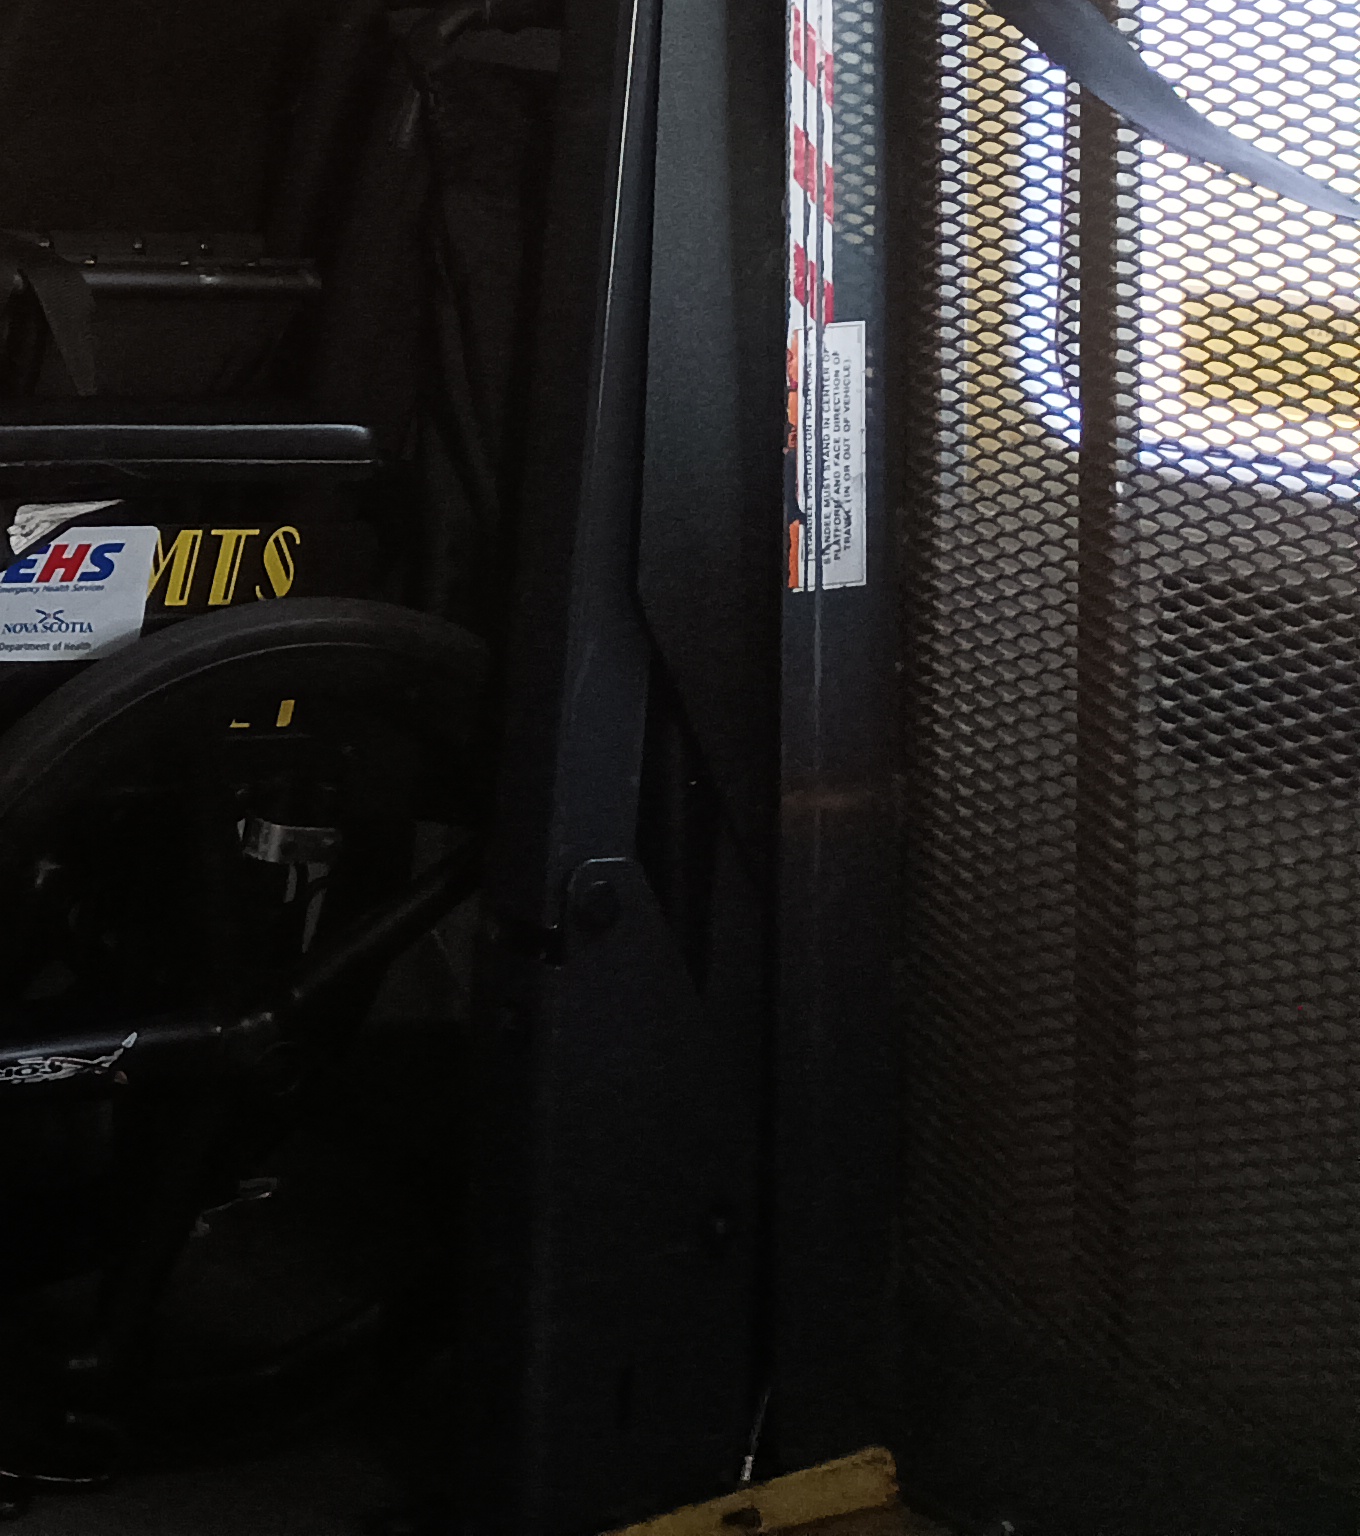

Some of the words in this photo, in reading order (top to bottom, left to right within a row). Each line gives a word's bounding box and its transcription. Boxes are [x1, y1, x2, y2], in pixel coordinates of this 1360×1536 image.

[833, 370, 841, 432] DIRECTION
[833, 437, 841, 466] FACE
[843, 438, 851, 460] OUT
[833, 471, 841, 494] AND
[0, 542, 126, 583] EHS
[42, 584, 69, 592] Health
[1, 622, 39, 634] NOVA
[41, 621, 93, 634] SCOTIA
[53, 641, 62, 651] of
